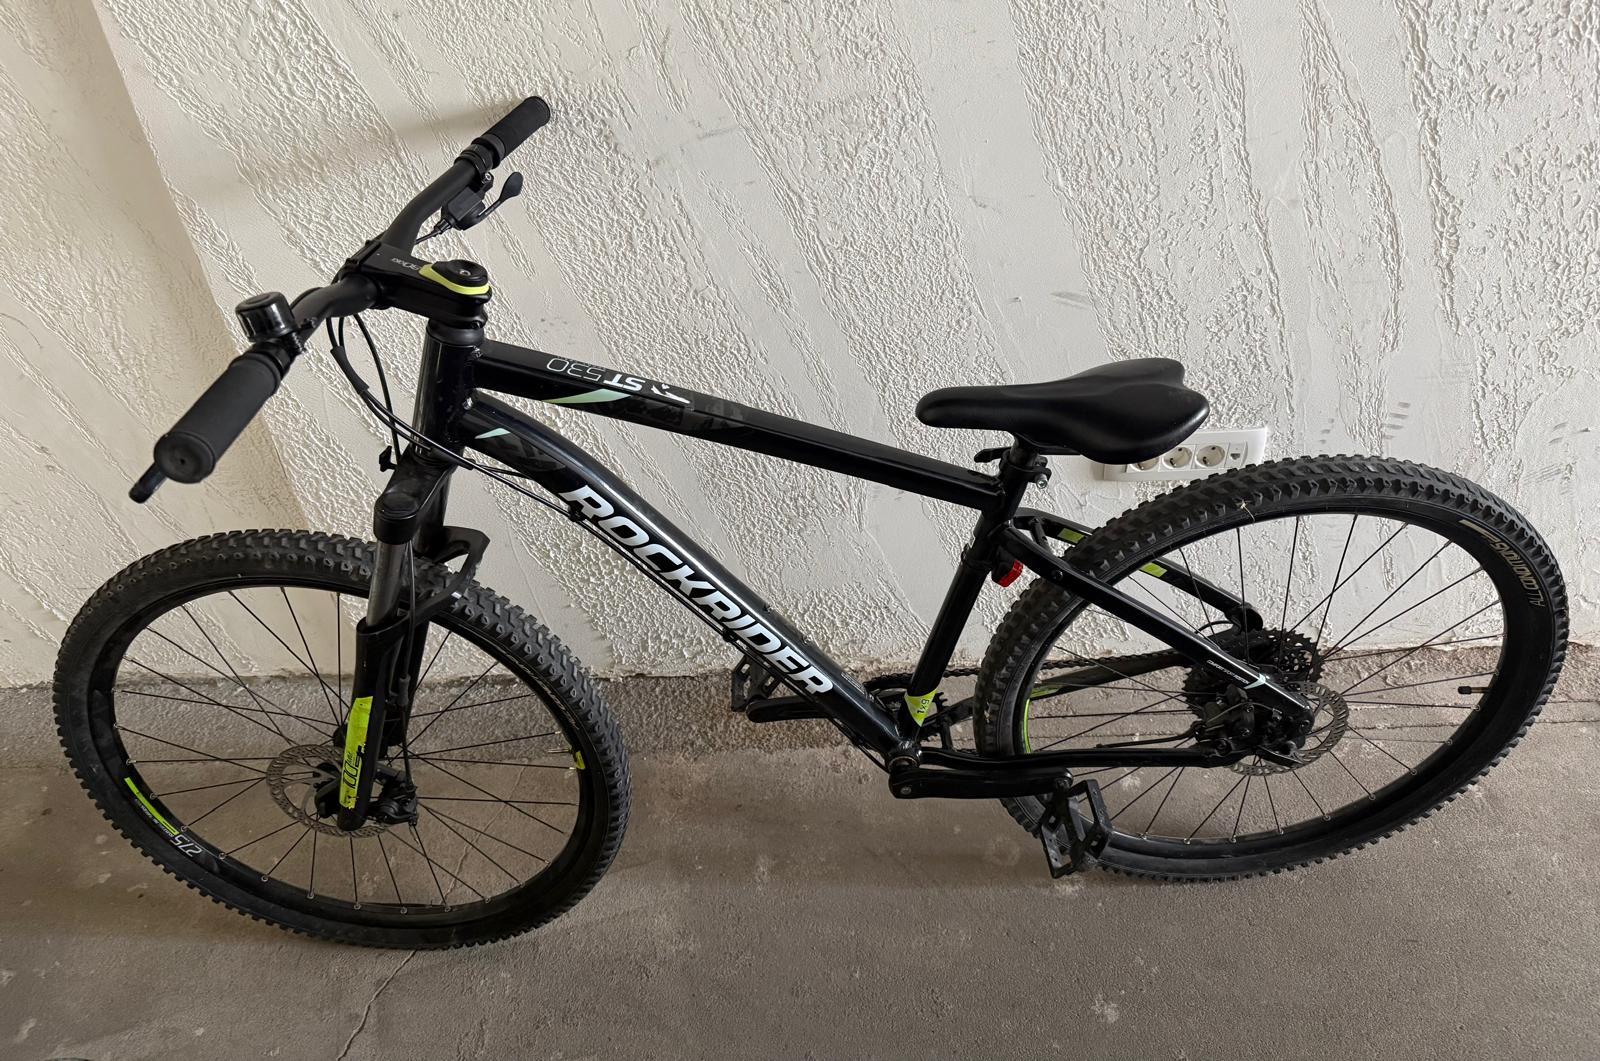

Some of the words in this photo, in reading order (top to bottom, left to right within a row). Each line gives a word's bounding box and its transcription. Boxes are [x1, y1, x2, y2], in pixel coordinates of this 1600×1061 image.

[547, 358, 602, 382] 530
[604, 373, 646, 391] ST
[1490, 541, 1539, 591] CONDITIONS
[559, 484, 834, 695] ROCKRIDER
[1527, 589, 1545, 607] ALL
[170, 834, 203, 858] 27.5
